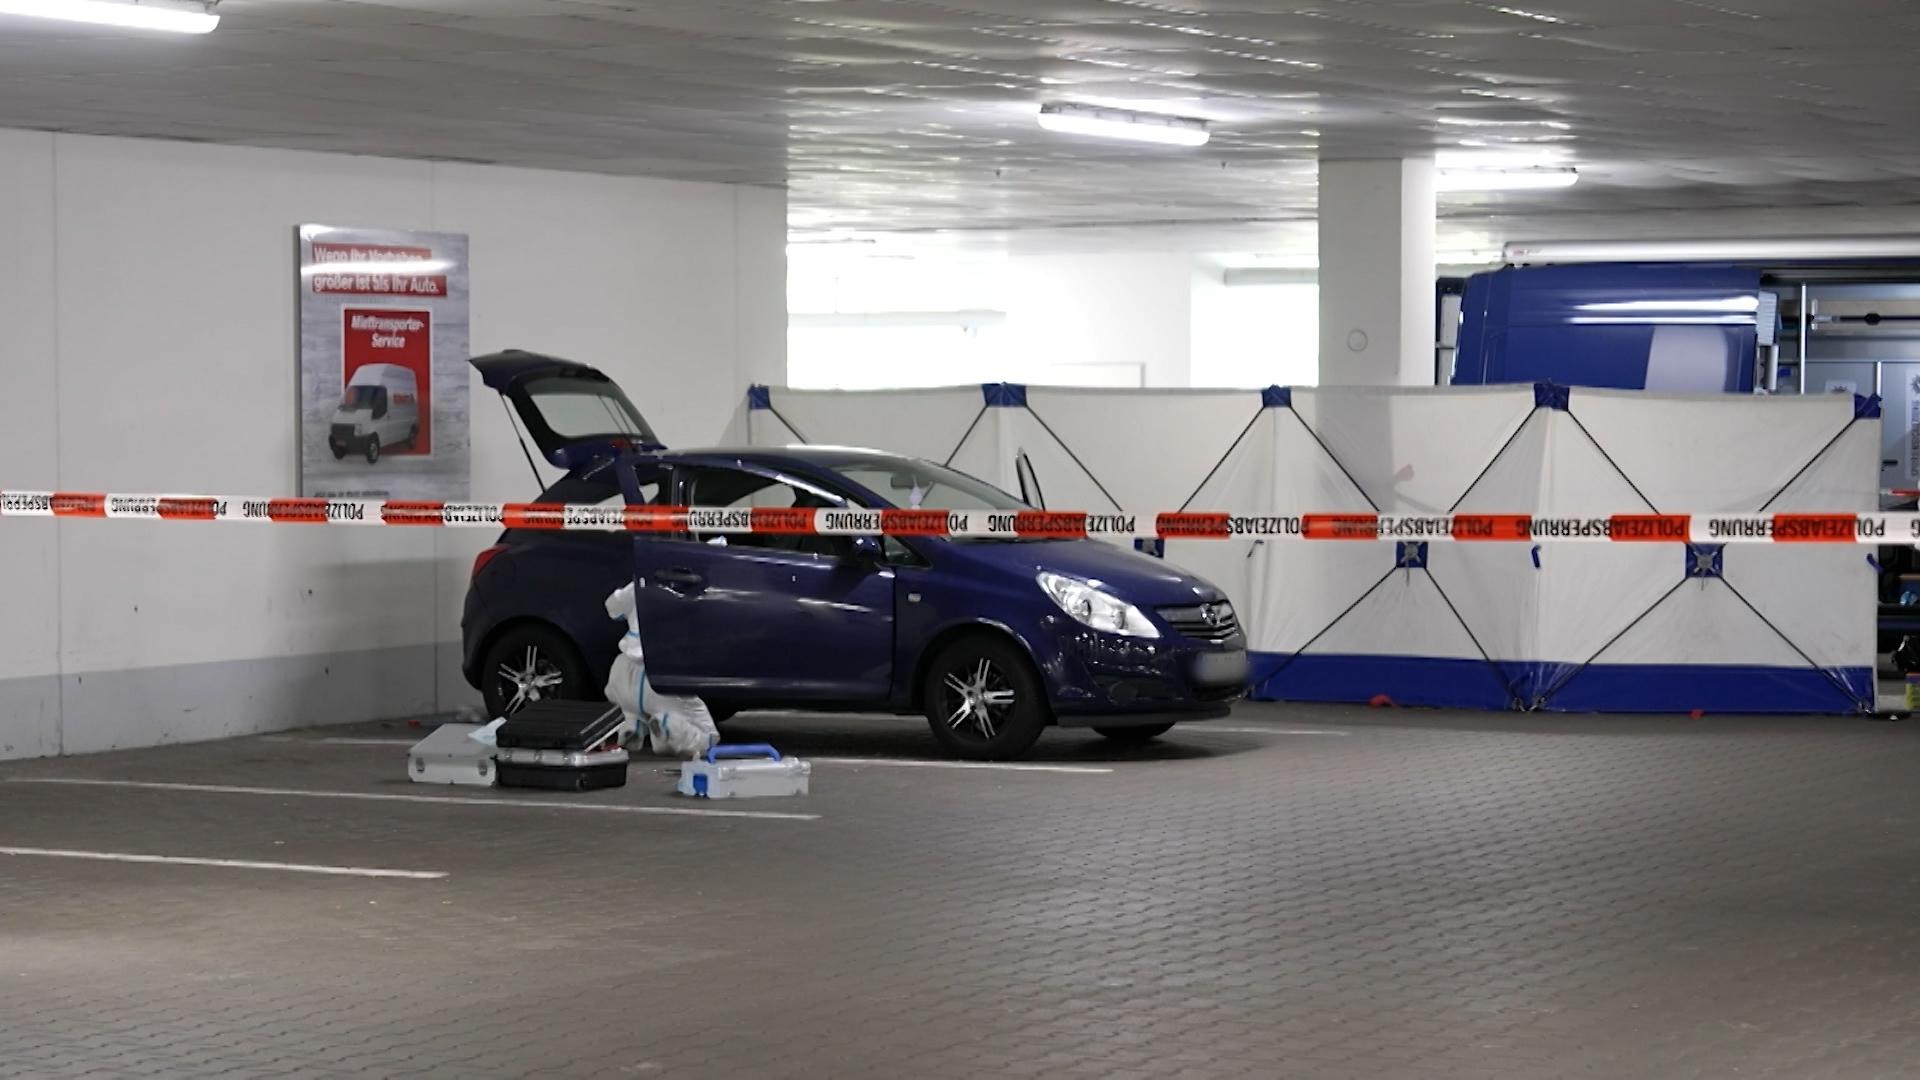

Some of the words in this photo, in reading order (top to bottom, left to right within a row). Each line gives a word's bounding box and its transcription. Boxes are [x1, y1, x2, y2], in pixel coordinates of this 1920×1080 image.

[314, 247, 349, 263] Wenn
[410, 276, 439, 294] Auto.
[371, 332, 405, 348] Service
[826, 512, 968, 532] POLIZEIABSPERRUNG
[988, 514, 1135, 532] POLIZEIABSPERRUNG
[1156, 515, 1310, 535] POLIZEIABSPERRUNG
[1331, 518, 1494, 536] POLIZEIABSPERRUNG
[1516, 518, 1685, 536] POLIZEIABSPERRUNG
[1709, 519, 1885, 537] POLIZEIABSPERRUNG
